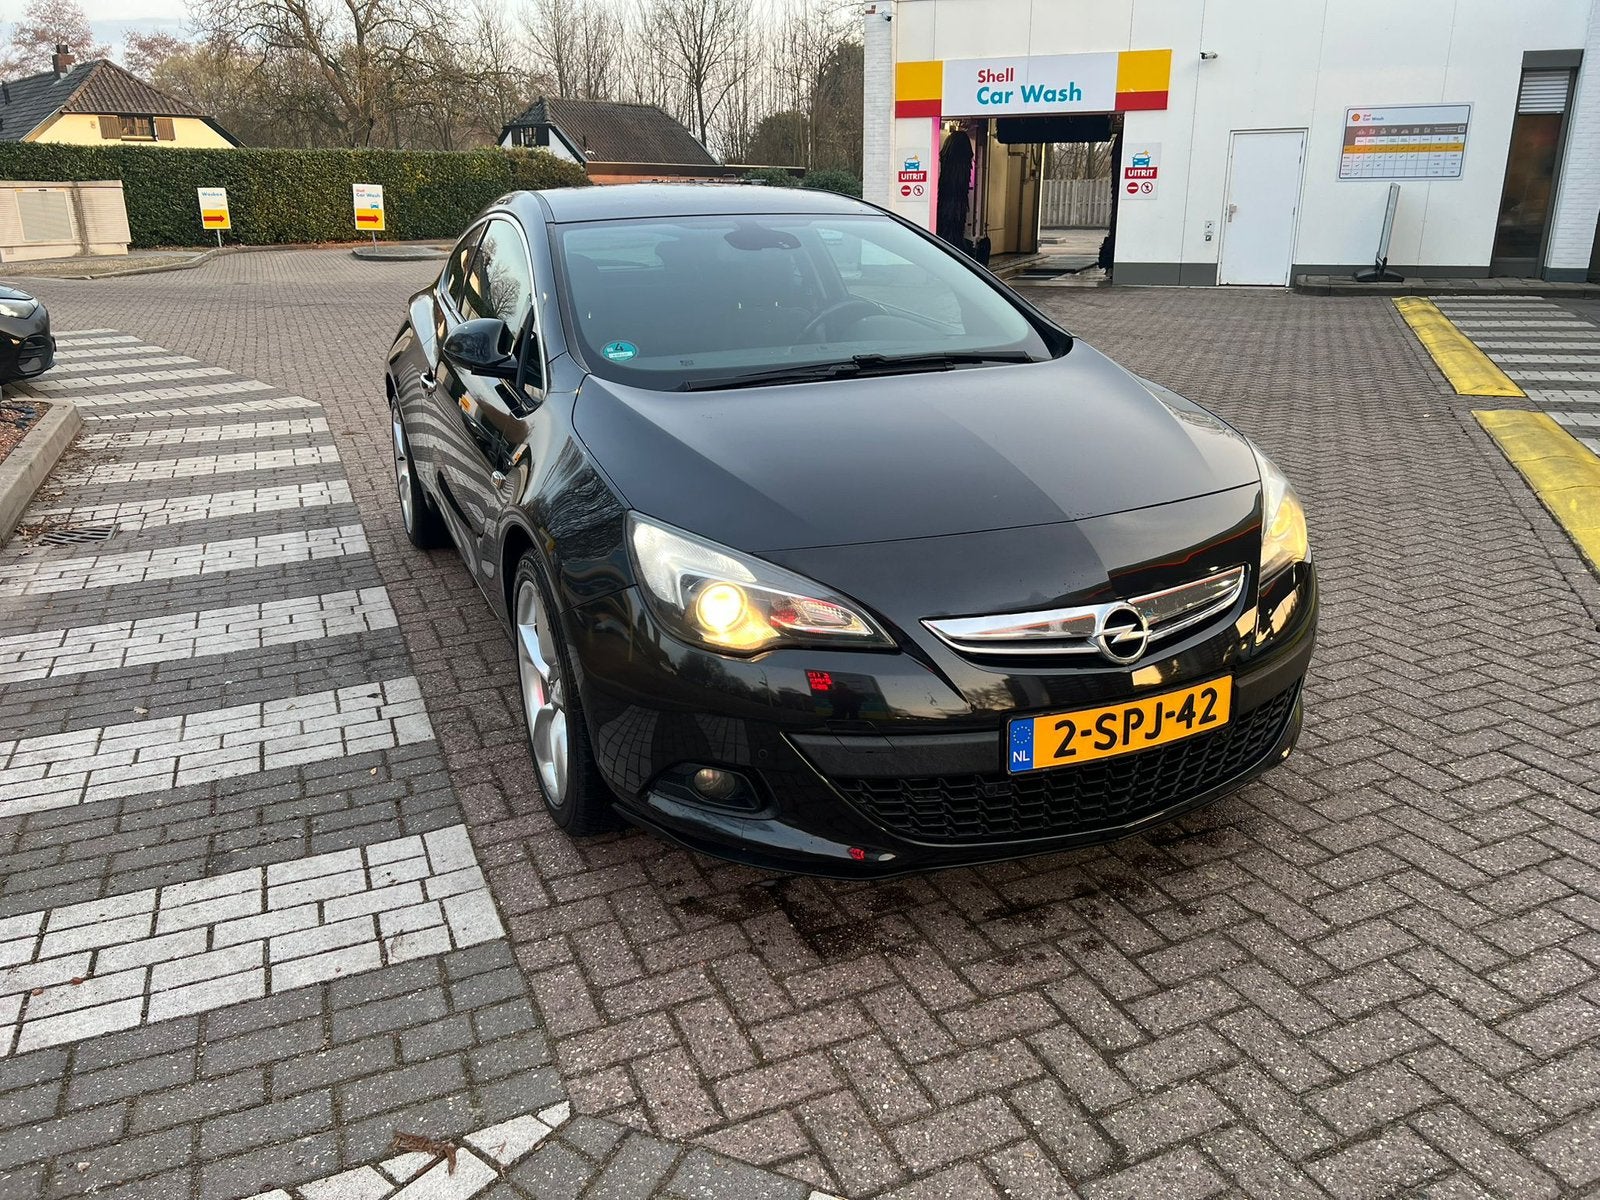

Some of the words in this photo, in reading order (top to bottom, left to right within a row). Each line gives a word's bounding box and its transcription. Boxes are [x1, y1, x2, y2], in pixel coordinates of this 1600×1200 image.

[977, 67, 1014, 84] Shell
[976, 86, 1014, 105] Car
[1020, 82, 1082, 103] Wash
[900, 172, 925, 181] UITRIT
[1127, 168, 1155, 178] UITRIT
[614, 343, 624, 351] 4
[1053, 687, 1218, 759] 2-SPJ-42
[1012, 750, 1031, 763] NL
